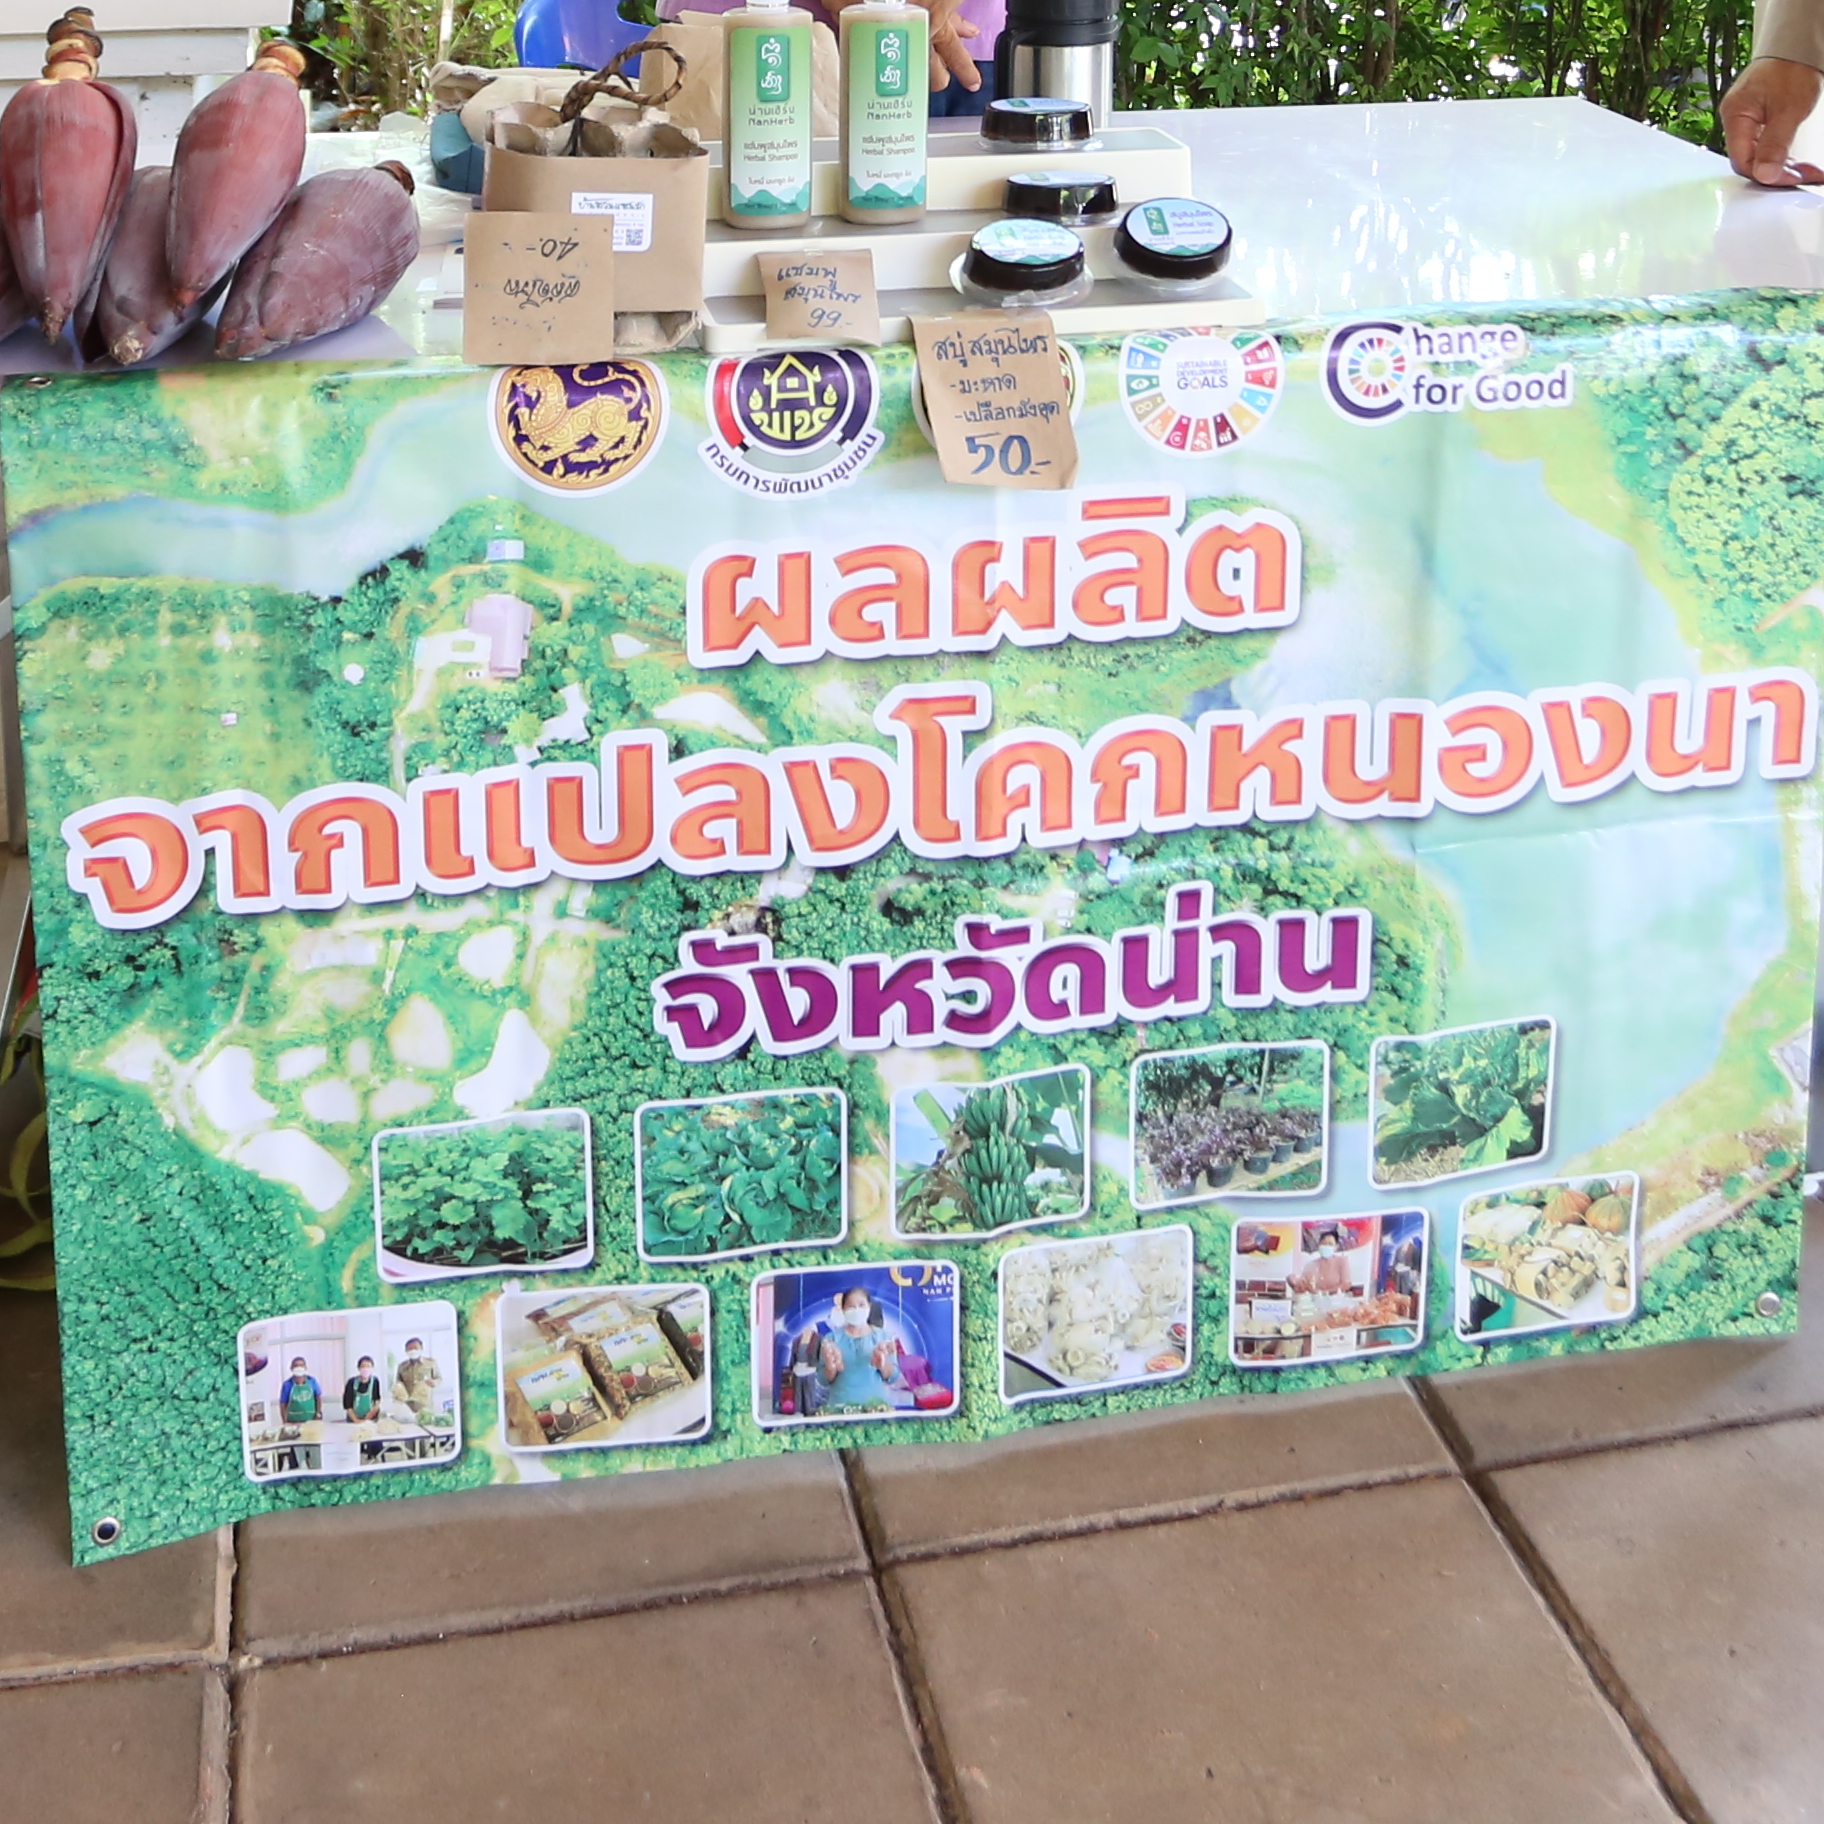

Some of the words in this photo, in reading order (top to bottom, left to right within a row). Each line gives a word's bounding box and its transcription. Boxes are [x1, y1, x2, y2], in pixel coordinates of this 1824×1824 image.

[748, 116, 795, 126] NanHerb
[866, 110, 913, 120] NanHerb
[743, 154, 766, 162] Herbal
[768, 153, 798, 162] Shampoo
[861, 147, 884, 155] Herbal
[886, 146, 915, 155] Shampoo
[776, 263, 838, 290] แชมพู
[783, 281, 862, 304] สมุนไพร
[932, 331, 969, 368] สบู่
[969, 327, 1050, 368] สมุนไพร
[1176, 360, 1228, 369] SUSTAINABLE
[1176, 369, 1228, 377] DEVELOPMENT
[1177, 376, 1228, 390] GOALS
[1412, 374, 1464, 405] for
[1475, 369, 1567, 404] Good
[705, 432, 878, 494] กรมการพัฒนาชุมชน
[701, 494, 1288, 654] ผลผลิต
[78, 682, 1806, 915] จากแปลงโคกหนองนา
[661, 888, 1364, 1054] จังหวัดน่าน
